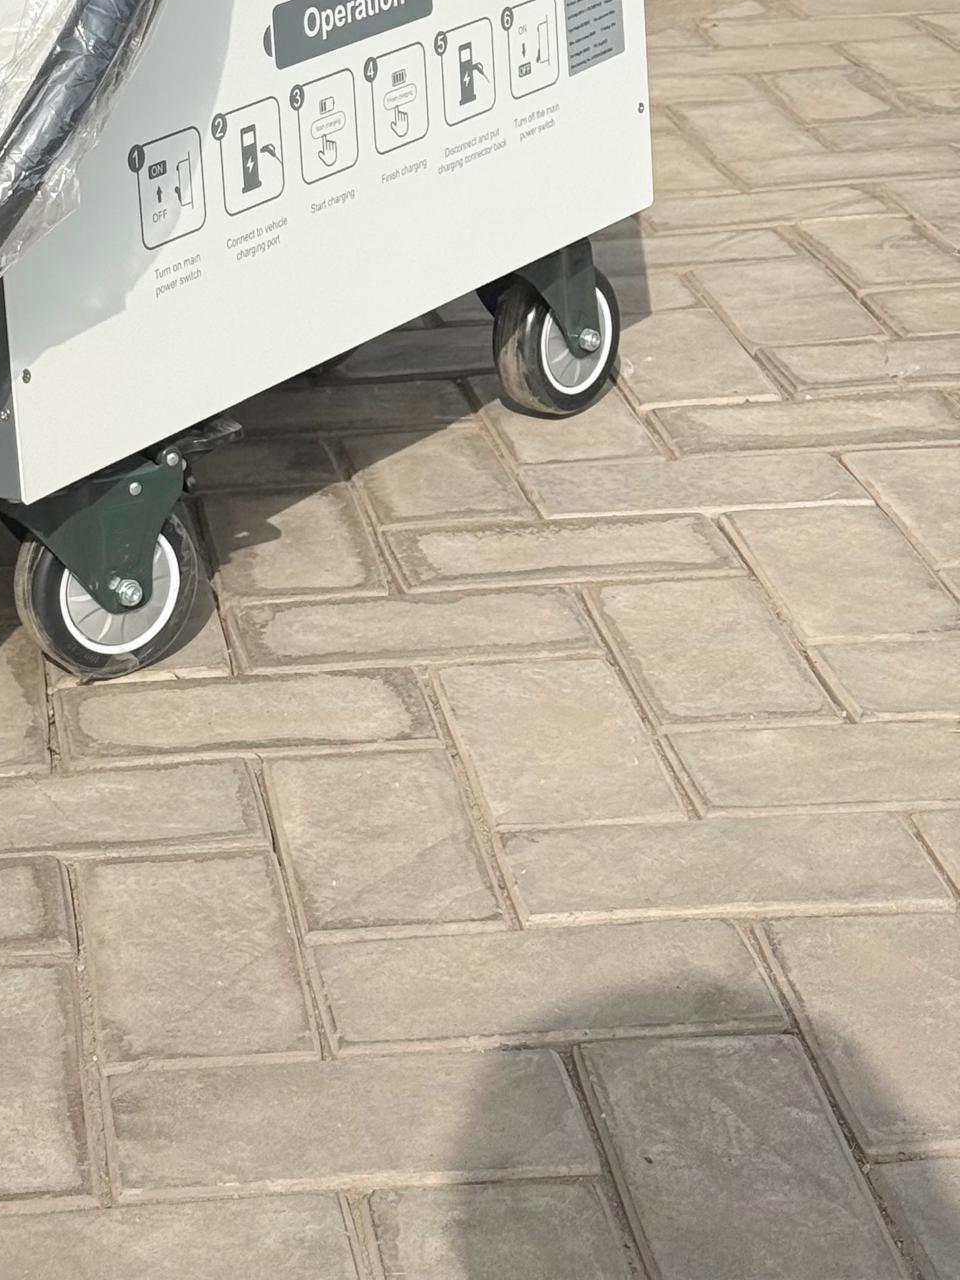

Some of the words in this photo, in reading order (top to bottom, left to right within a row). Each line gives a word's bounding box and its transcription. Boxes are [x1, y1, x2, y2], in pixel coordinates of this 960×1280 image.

[504, 11, 512, 28] 6
[437, 34, 445, 54] 5
[366, 60, 375, 79] 4
[293, 88, 302, 107] 3
[214, 119, 224, 138] 2
[151, 164, 164, 177] ON
[401, 159, 428, 177] charging
[310, 199, 327, 214] Start
[327, 189, 355, 207] charging
[152, 208, 167, 223] OFF
[226, 229, 256, 249] Connect
[256, 227, 264, 237] to
[264, 217, 288, 232] vehicle
[236, 241, 266, 261] charging
[267, 234, 280, 250] port
[154, 268, 171, 280] Turn
[172, 262, 182, 272] on
[183, 253, 201, 268] main
[155, 279, 178, 299] power
